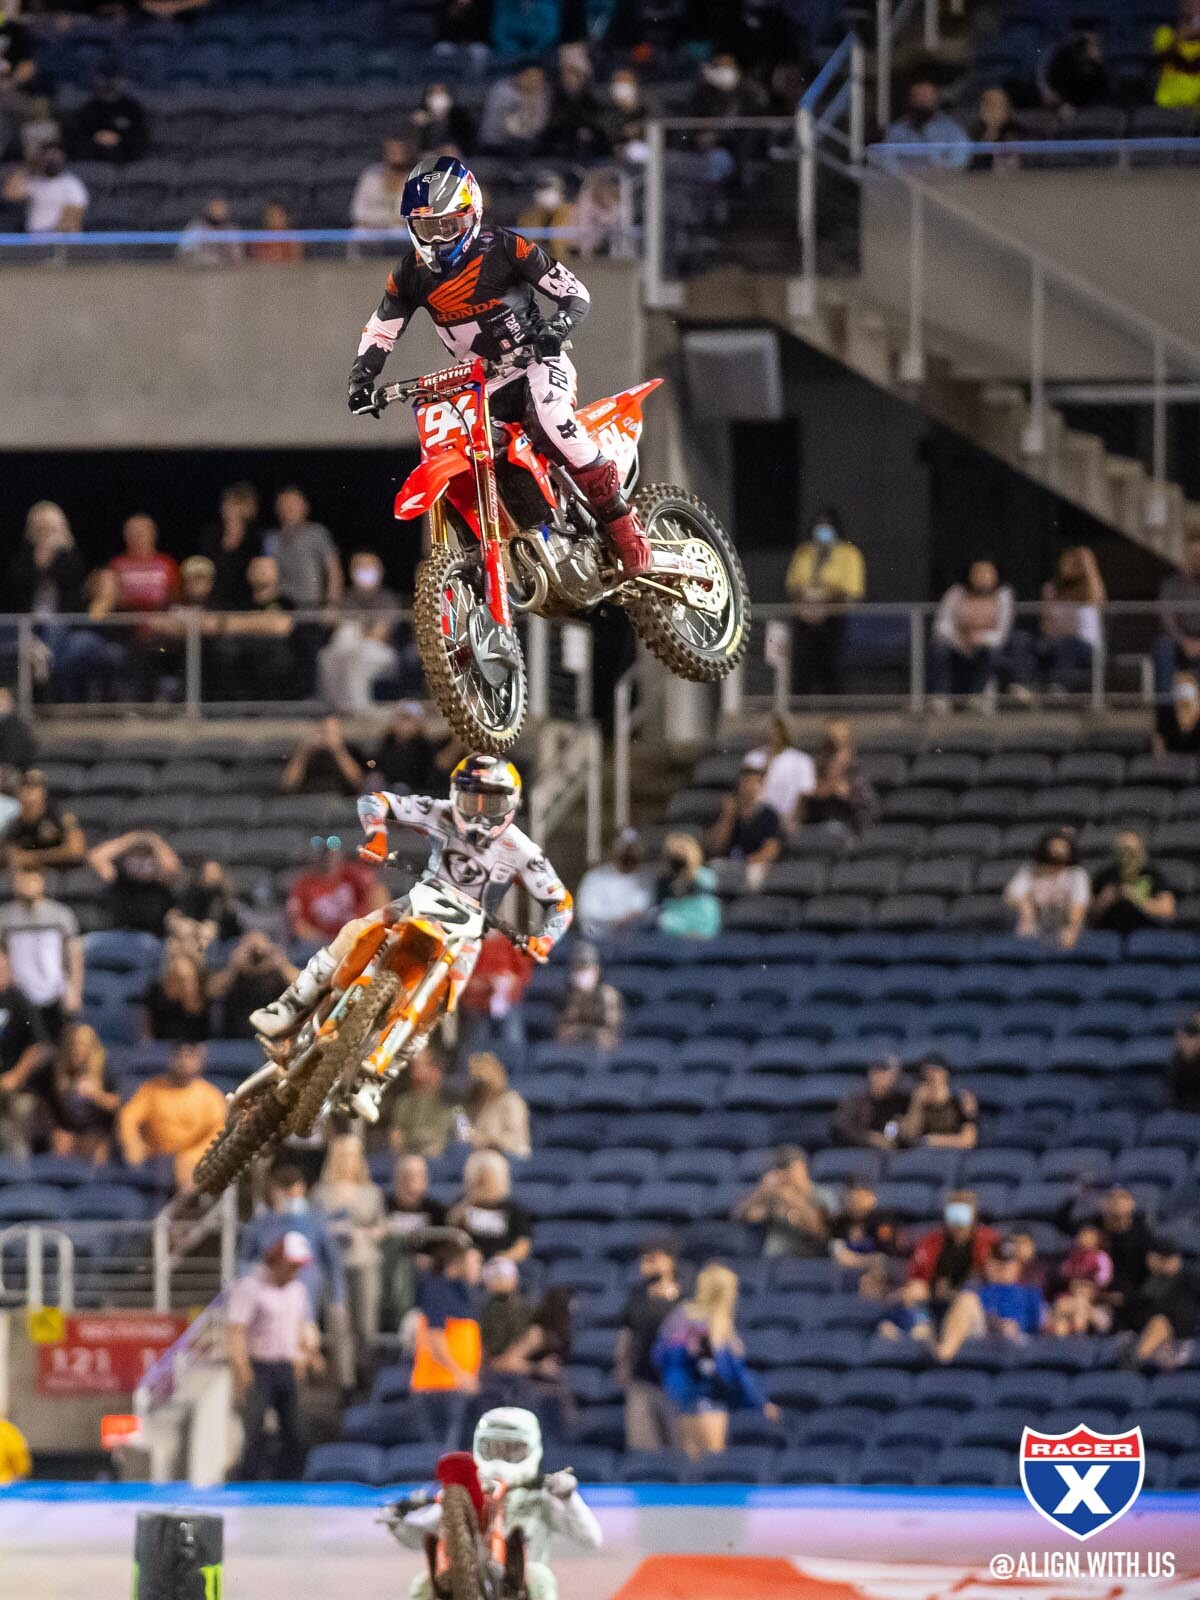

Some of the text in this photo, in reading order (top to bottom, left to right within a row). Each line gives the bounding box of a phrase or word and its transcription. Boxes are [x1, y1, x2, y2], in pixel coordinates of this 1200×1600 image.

[436, 298, 504, 322] HONDA
[424, 366, 472, 387] RENTHA
[425, 394, 477, 448] 94
